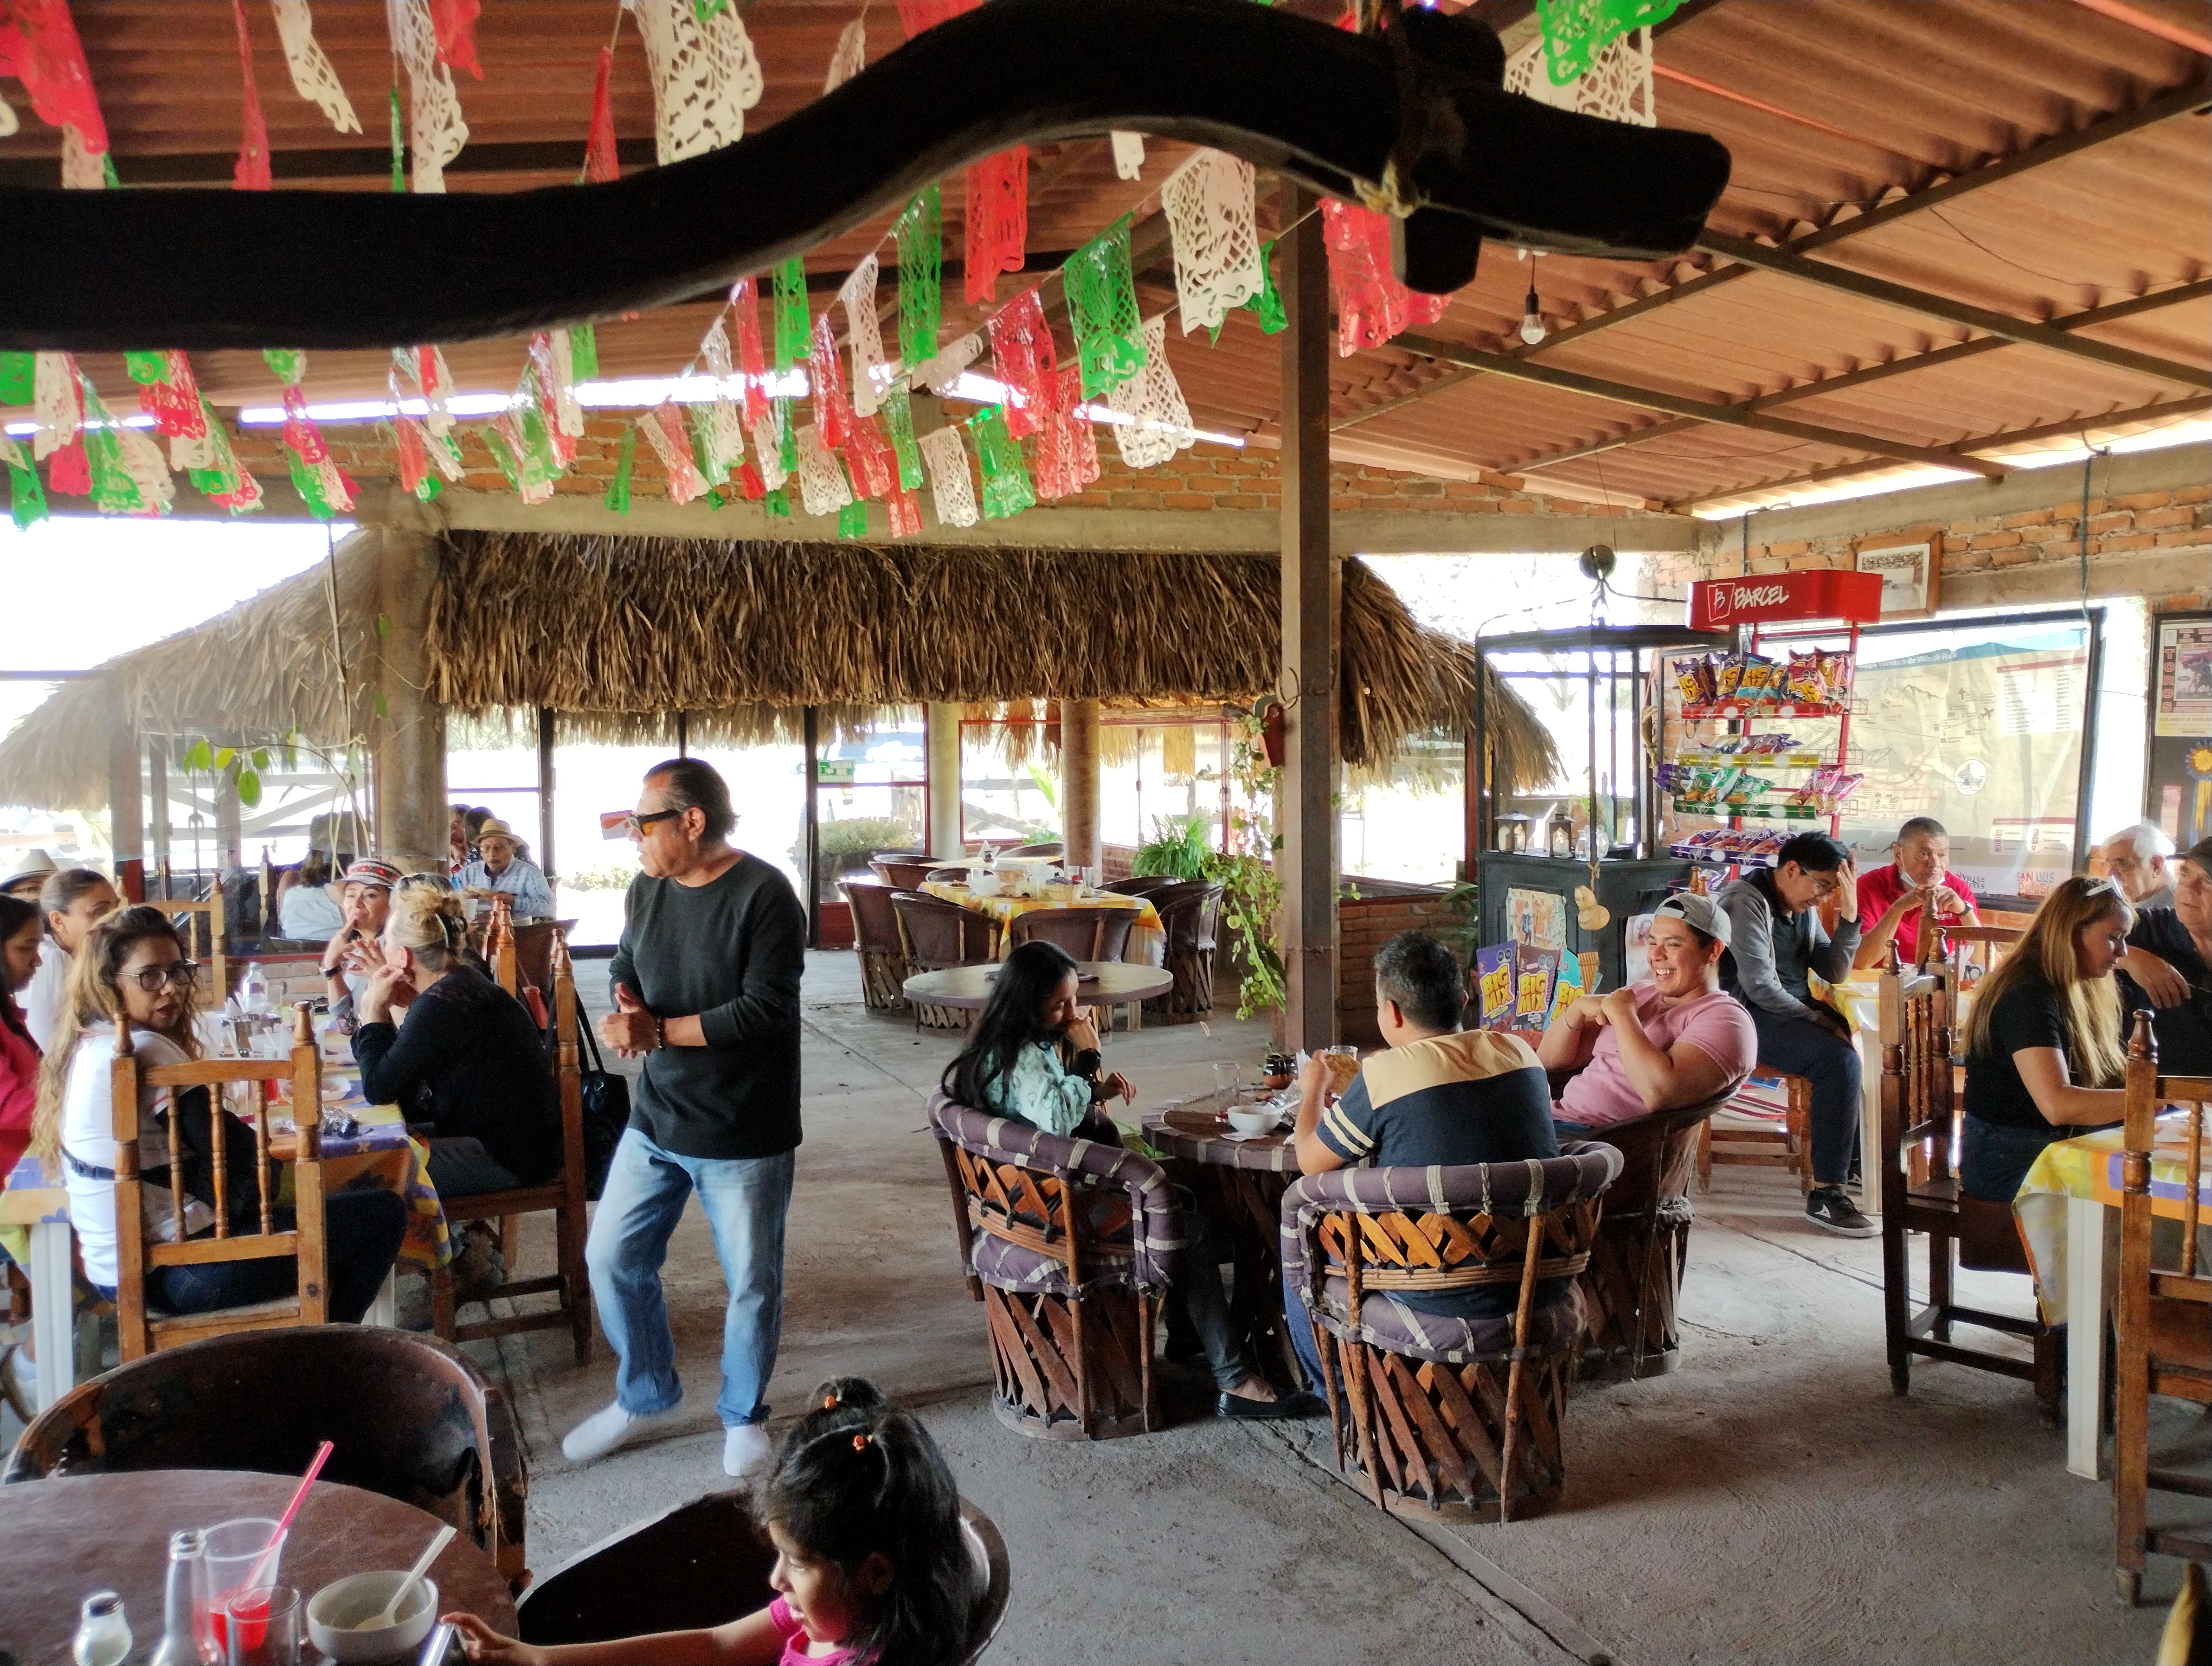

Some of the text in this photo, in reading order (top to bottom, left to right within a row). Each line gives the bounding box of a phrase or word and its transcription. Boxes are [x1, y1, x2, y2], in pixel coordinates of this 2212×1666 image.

[1735, 585, 1789, 610] BARCEL
[2162, 649, 2175, 712] TOROS
[2017, 872, 2055, 883] SAN LUIS
[1481, 964, 1510, 998] BIG
[1519, 971, 1547, 996] BIG
[1484, 983, 1514, 1016] MIX
[1516, 991, 1548, 1015] MIX
